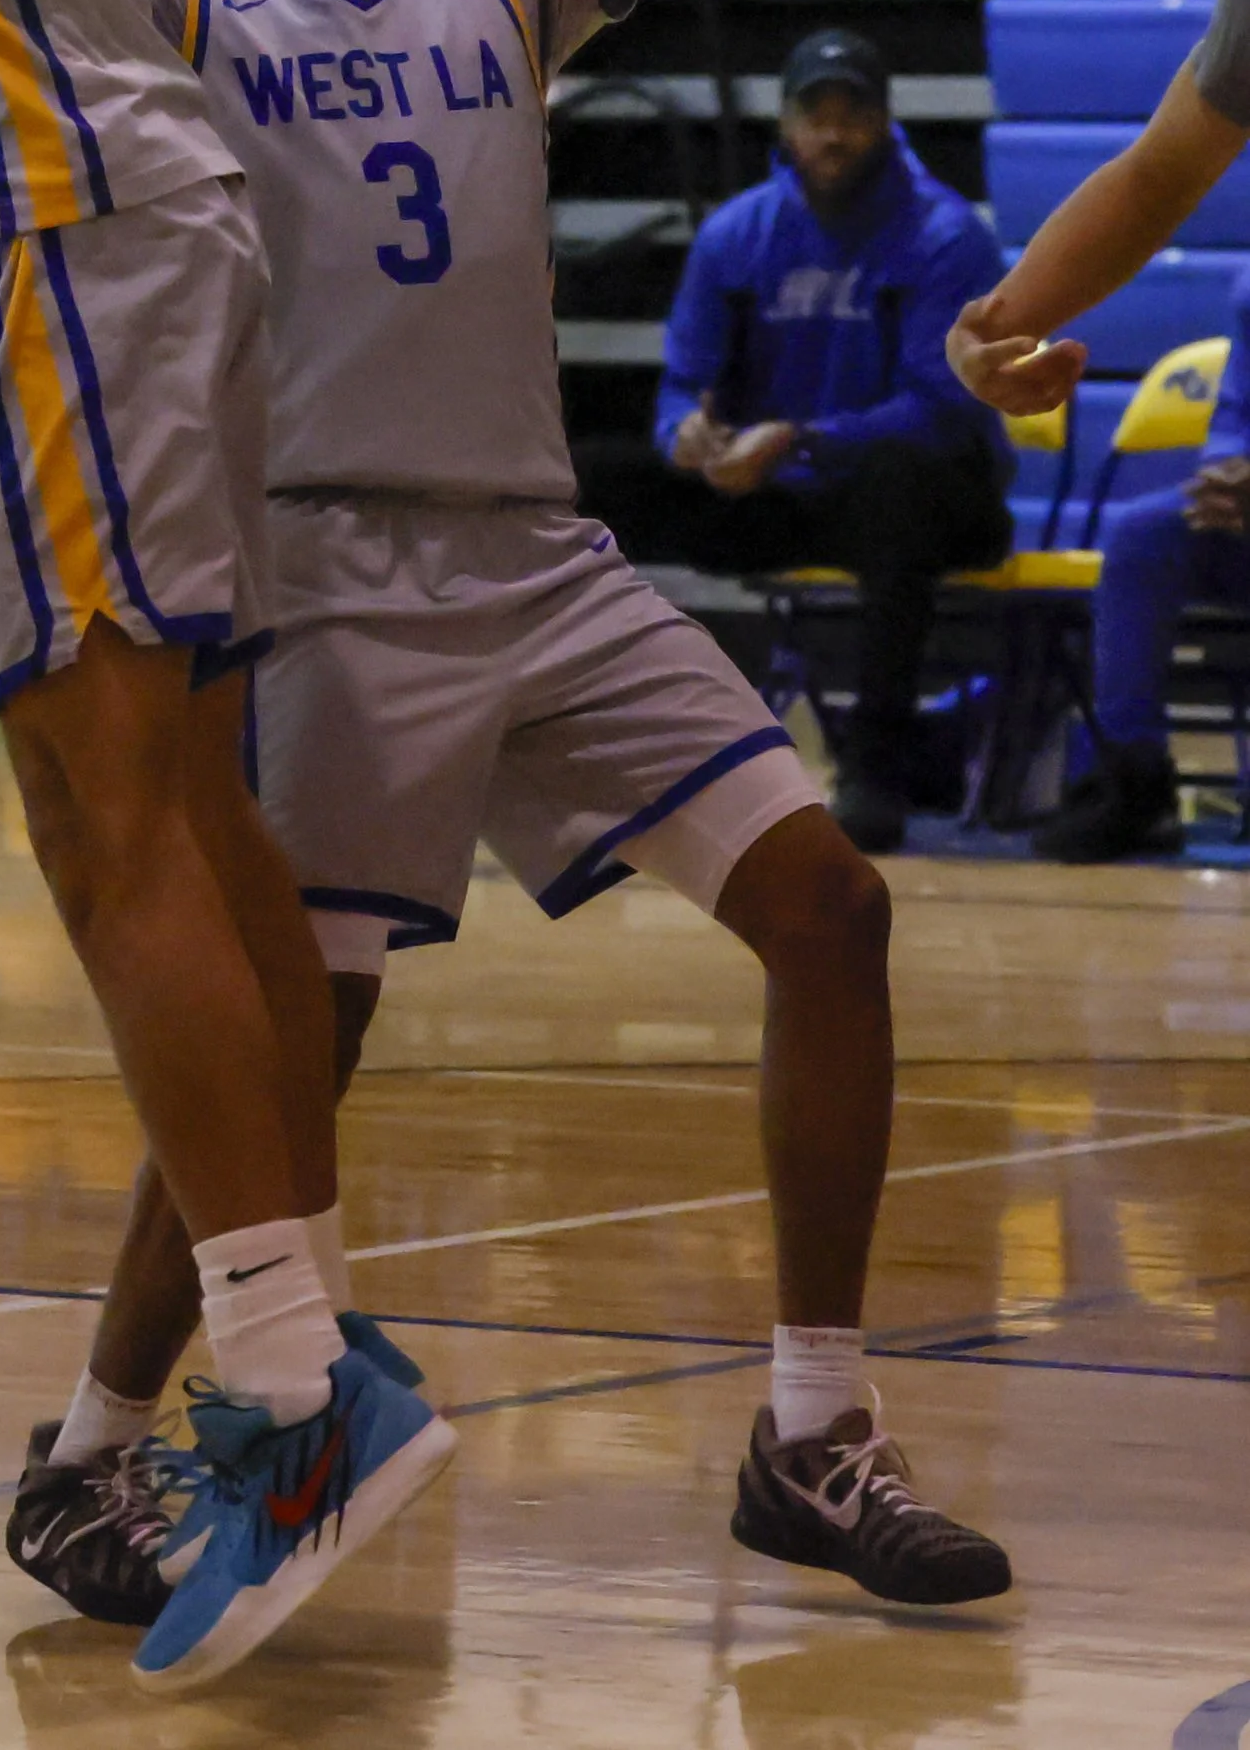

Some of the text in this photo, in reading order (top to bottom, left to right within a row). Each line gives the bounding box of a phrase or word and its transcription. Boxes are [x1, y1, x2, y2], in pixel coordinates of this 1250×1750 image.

[234, 38, 514, 126] WEST LA
[361, 140, 452, 286] 3
